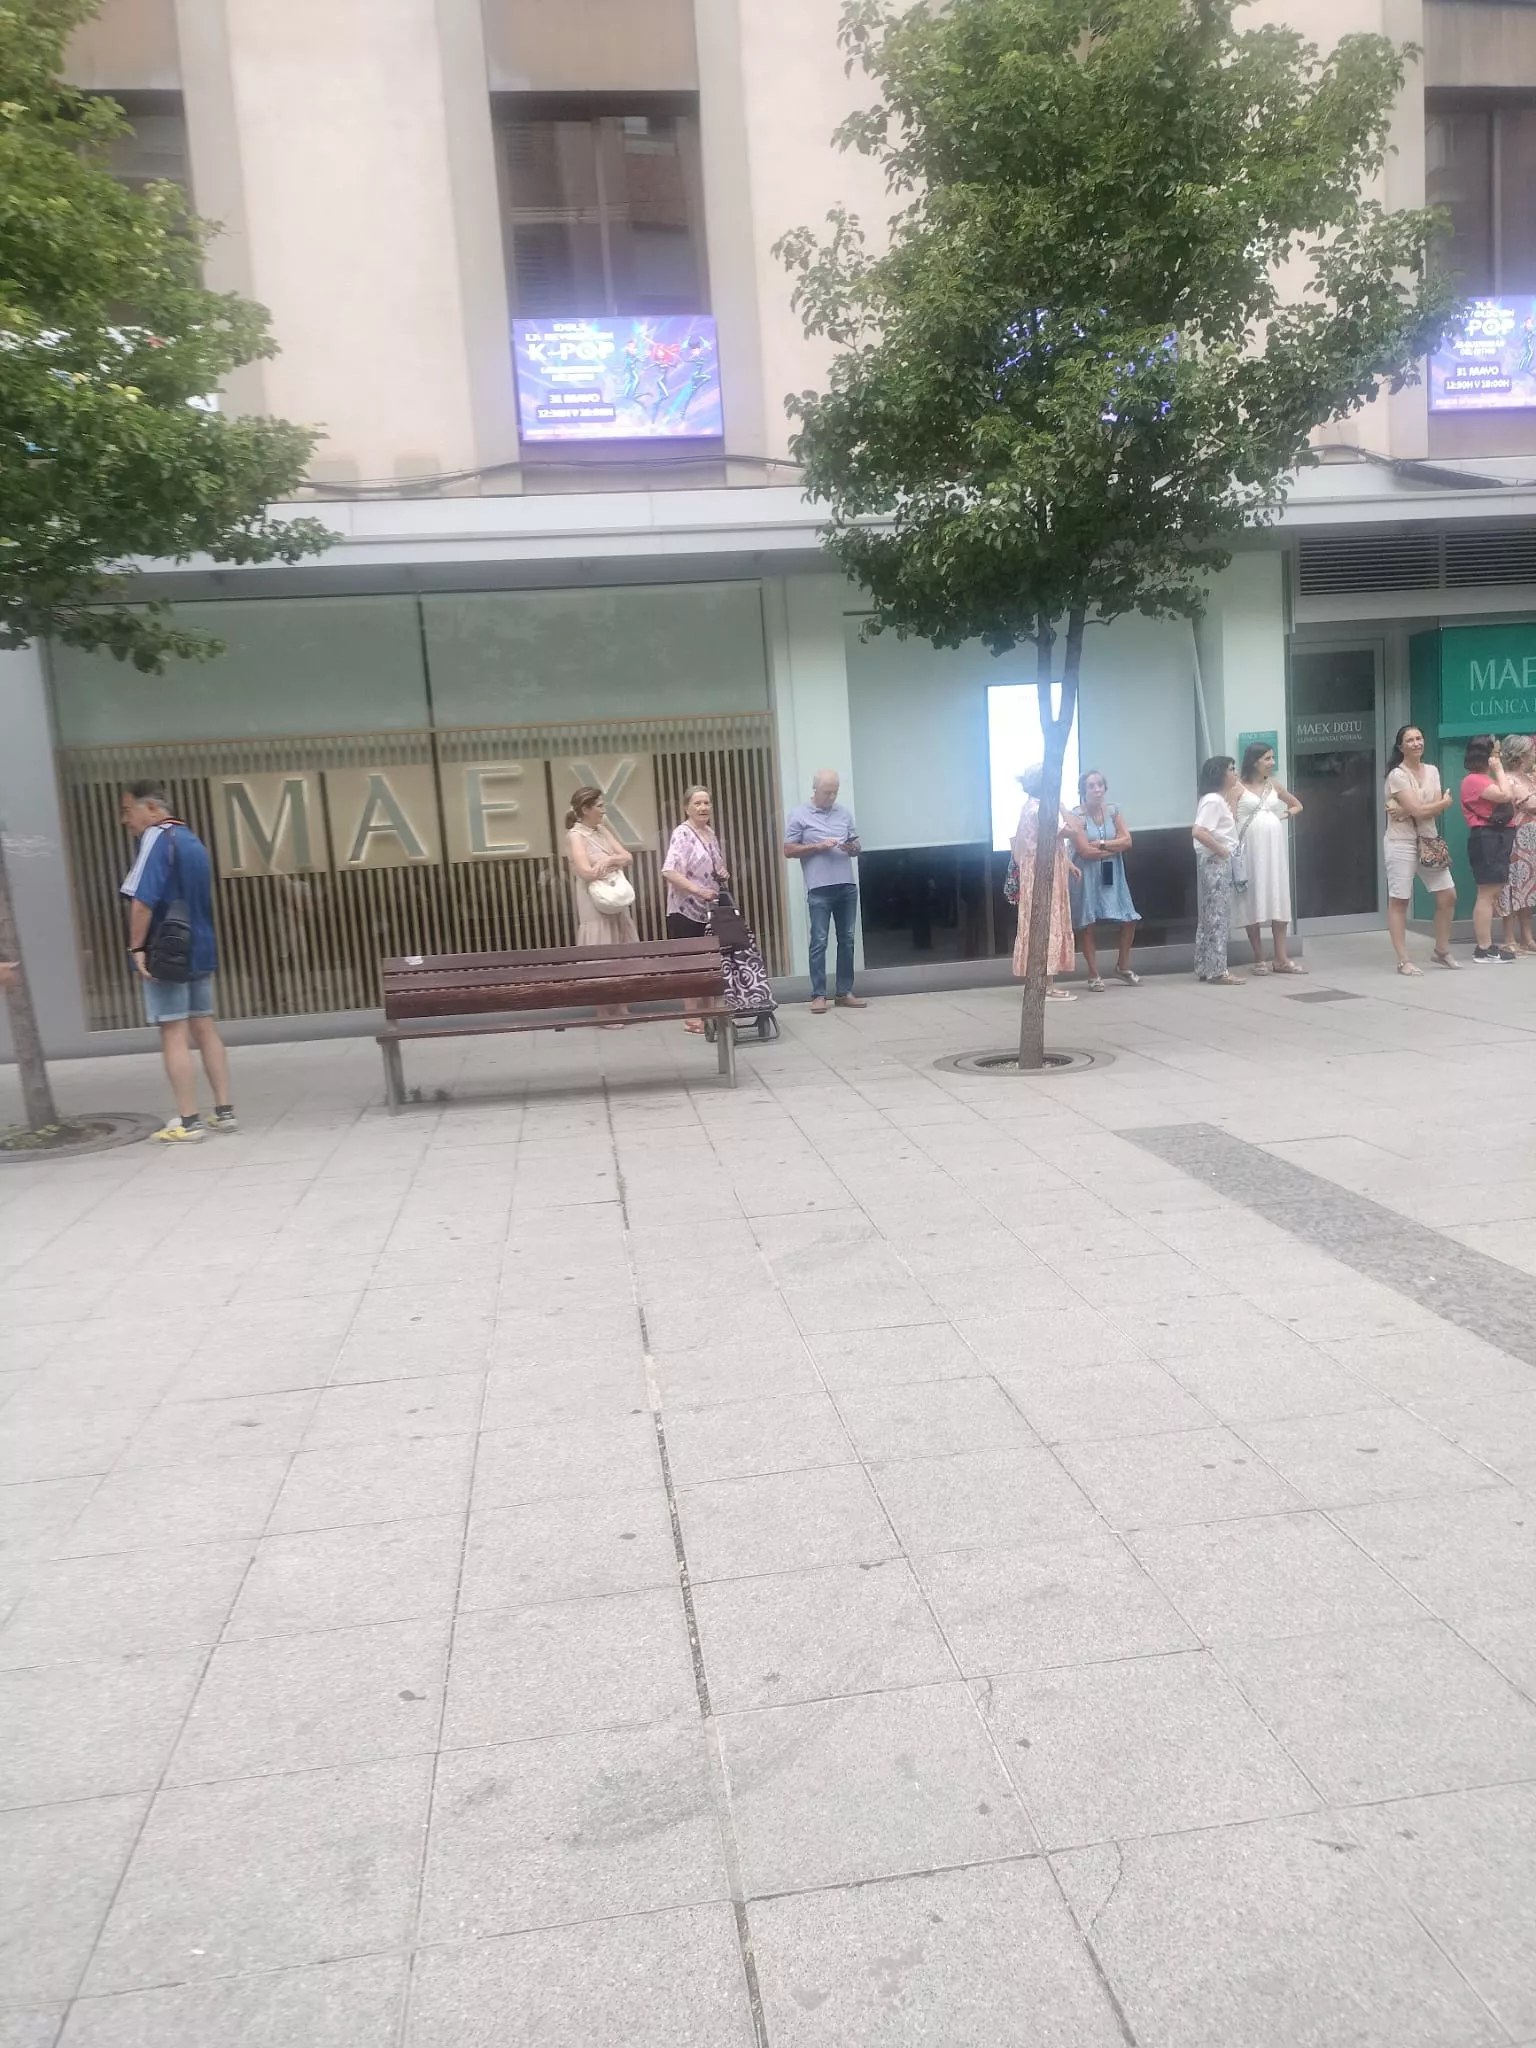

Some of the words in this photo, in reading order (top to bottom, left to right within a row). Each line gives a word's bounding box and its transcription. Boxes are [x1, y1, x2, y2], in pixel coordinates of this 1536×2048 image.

[1452, 319, 1515, 337] -POP
[528, 341, 615, 361] K-POP
[1470, 696, 1530, 717] CLÍNICA
[1297, 722, 1330, 736] MAEX
[1333, 720, 1362, 734] DOTU
[221, 758, 645, 873] MAEX
